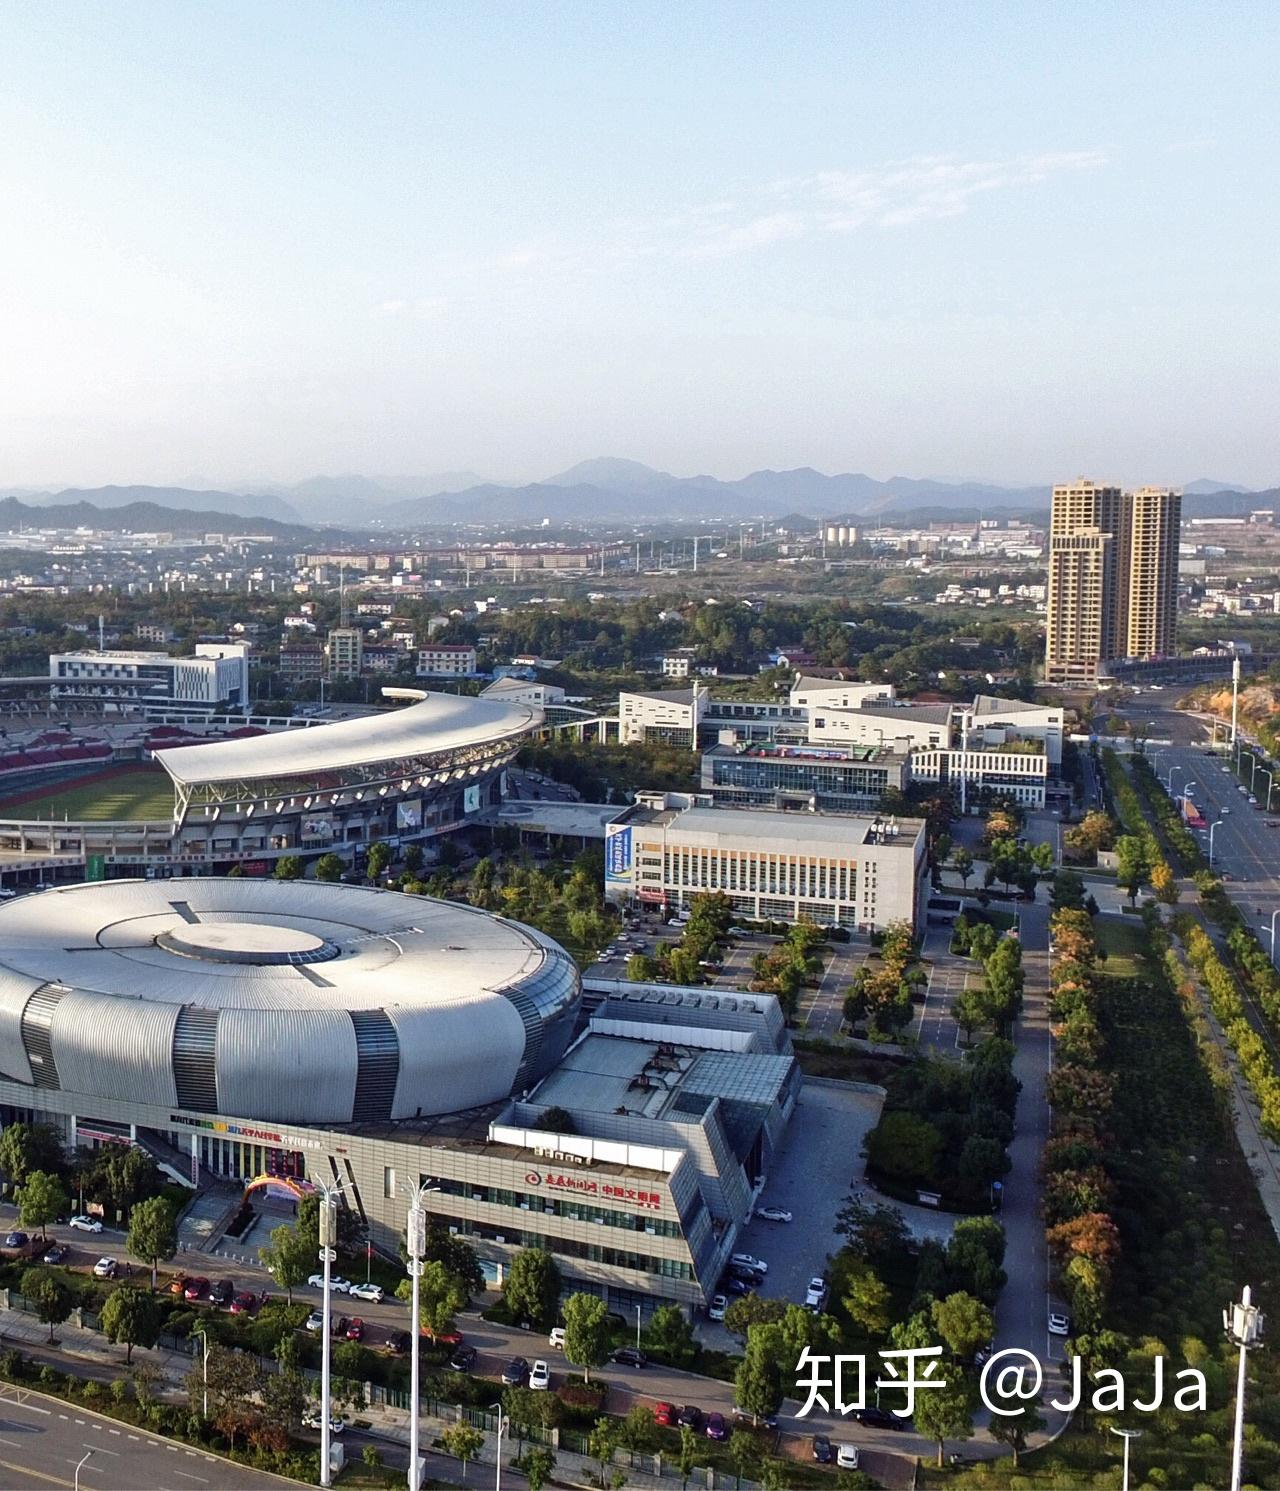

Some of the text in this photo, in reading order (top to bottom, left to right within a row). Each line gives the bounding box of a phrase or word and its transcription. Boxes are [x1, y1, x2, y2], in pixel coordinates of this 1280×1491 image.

[602, 1185, 661, 1204] 中国文明网
